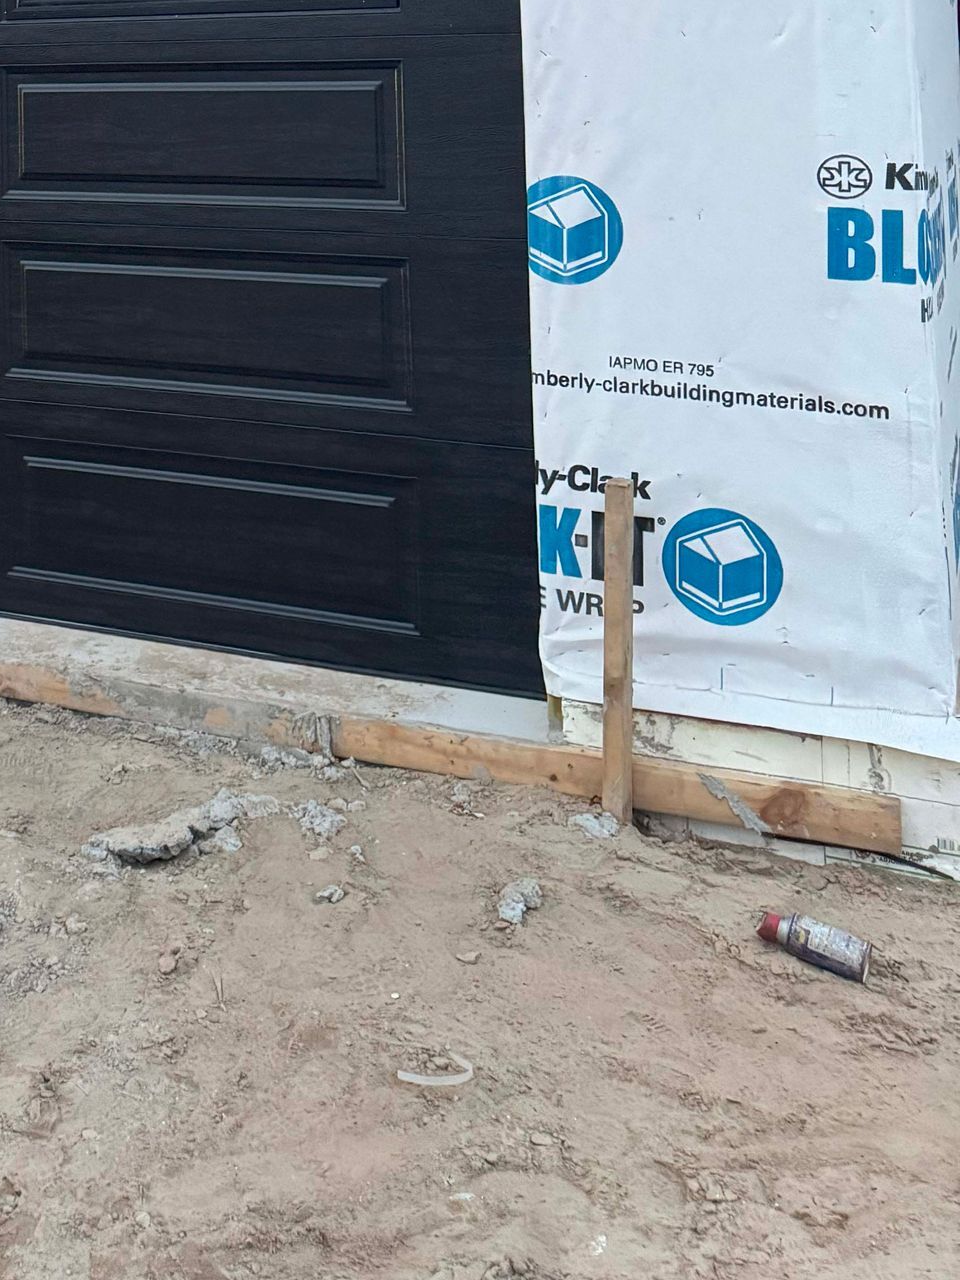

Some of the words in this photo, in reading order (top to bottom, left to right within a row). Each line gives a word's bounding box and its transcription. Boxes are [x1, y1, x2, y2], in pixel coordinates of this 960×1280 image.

[609, 355, 659, 373] IAPMO
[662, 360, 684, 375] ER
[688, 362, 715, 378] 795
